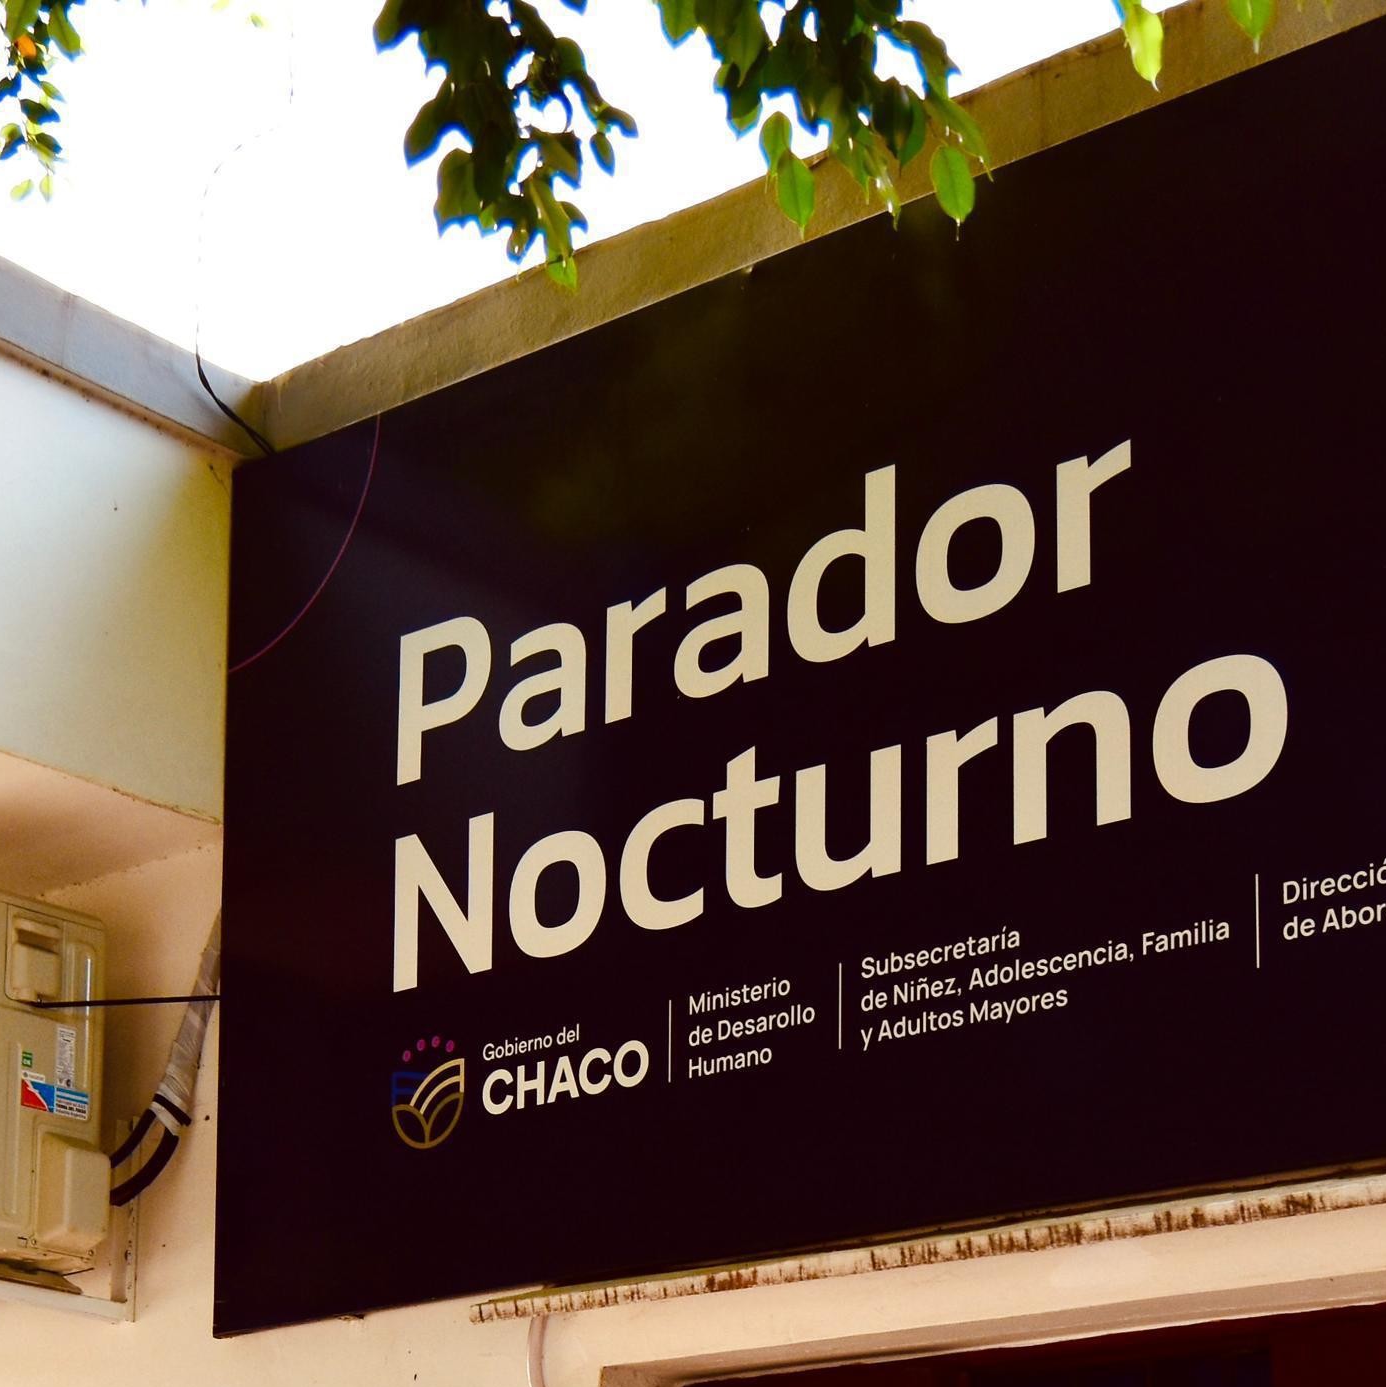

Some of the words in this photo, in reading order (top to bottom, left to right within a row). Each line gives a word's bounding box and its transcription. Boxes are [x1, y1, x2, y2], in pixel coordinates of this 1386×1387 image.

[396, 439, 1132, 786] Parador
[392, 653, 1288, 993] Nocturno
[860, 925, 1021, 979] Subsecretaría
[1282, 915, 1316, 941] de
[860, 989, 888, 1012] de
[893, 976, 963, 1006] Niñez,
[968, 939, 1135, 991] Adolescencia,
[1142, 920, 1231, 956] Familia
[689, 977, 791, 1016] Ministerio
[860, 1027, 874, 1052] y
[877, 1009, 965, 1042] Adultos
[969, 989, 1069, 1024] Mayores
[482, 1034, 554, 1061] Gobierno
[556, 1023, 580, 1046] del
[688, 1025, 713, 1047] de
[717, 1003, 816, 1041] Desarollo
[481, 1039, 650, 1115] CHACO
[688, 1047, 773, 1079] Humano
